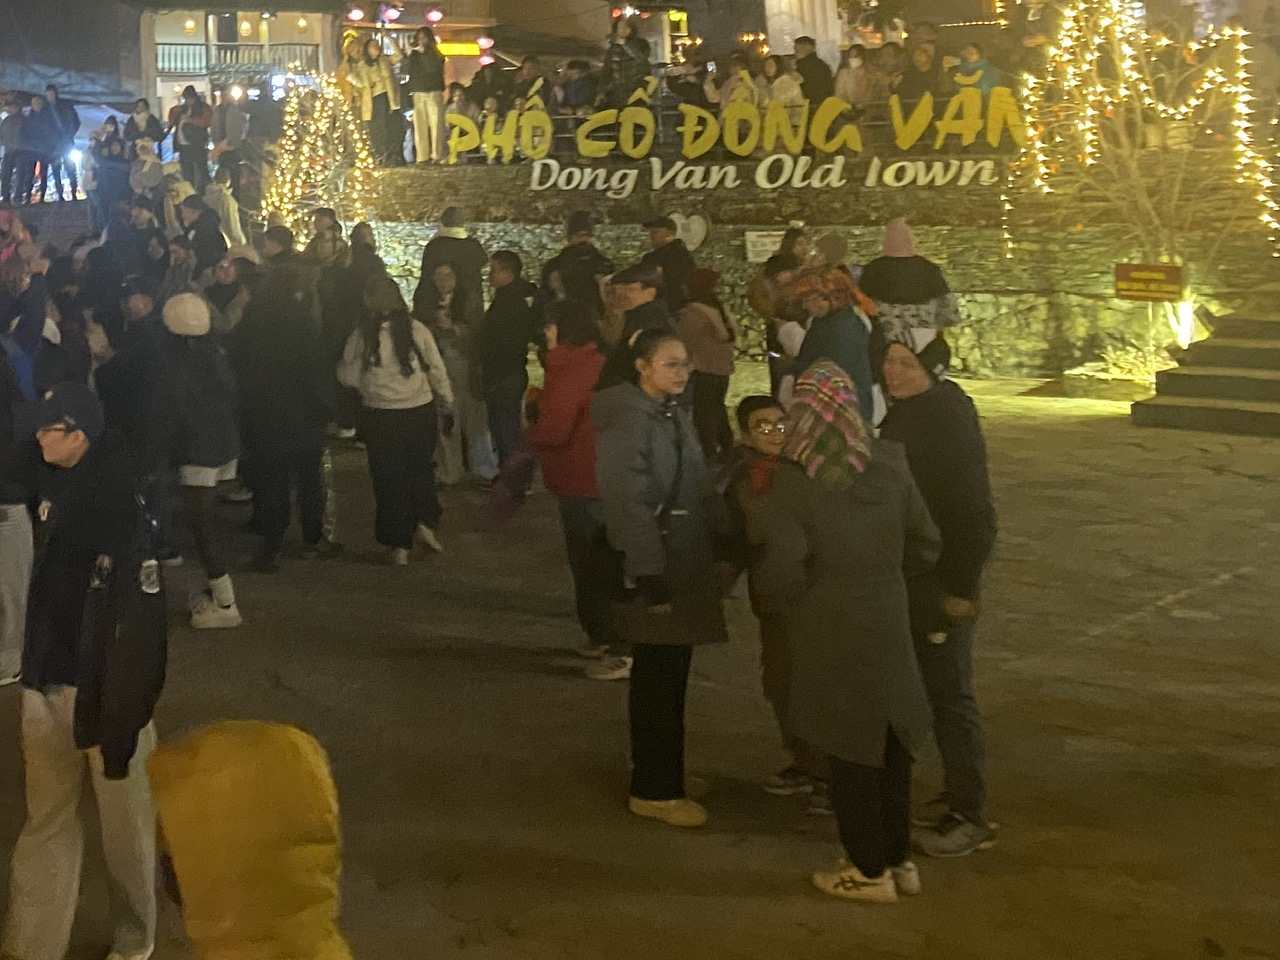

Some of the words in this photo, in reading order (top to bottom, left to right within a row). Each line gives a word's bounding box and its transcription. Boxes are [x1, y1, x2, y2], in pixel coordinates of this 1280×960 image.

[445, 76, 552, 165] PHỐ
[576, 75, 656, 159] CỔ
[677, 70, 863, 160] ĐỒNG
[888, 69, 1029, 150] VĂN
[530, 158, 638, 199] Dong
[649, 157, 741, 190] Van
[754, 153, 847, 189] Old
